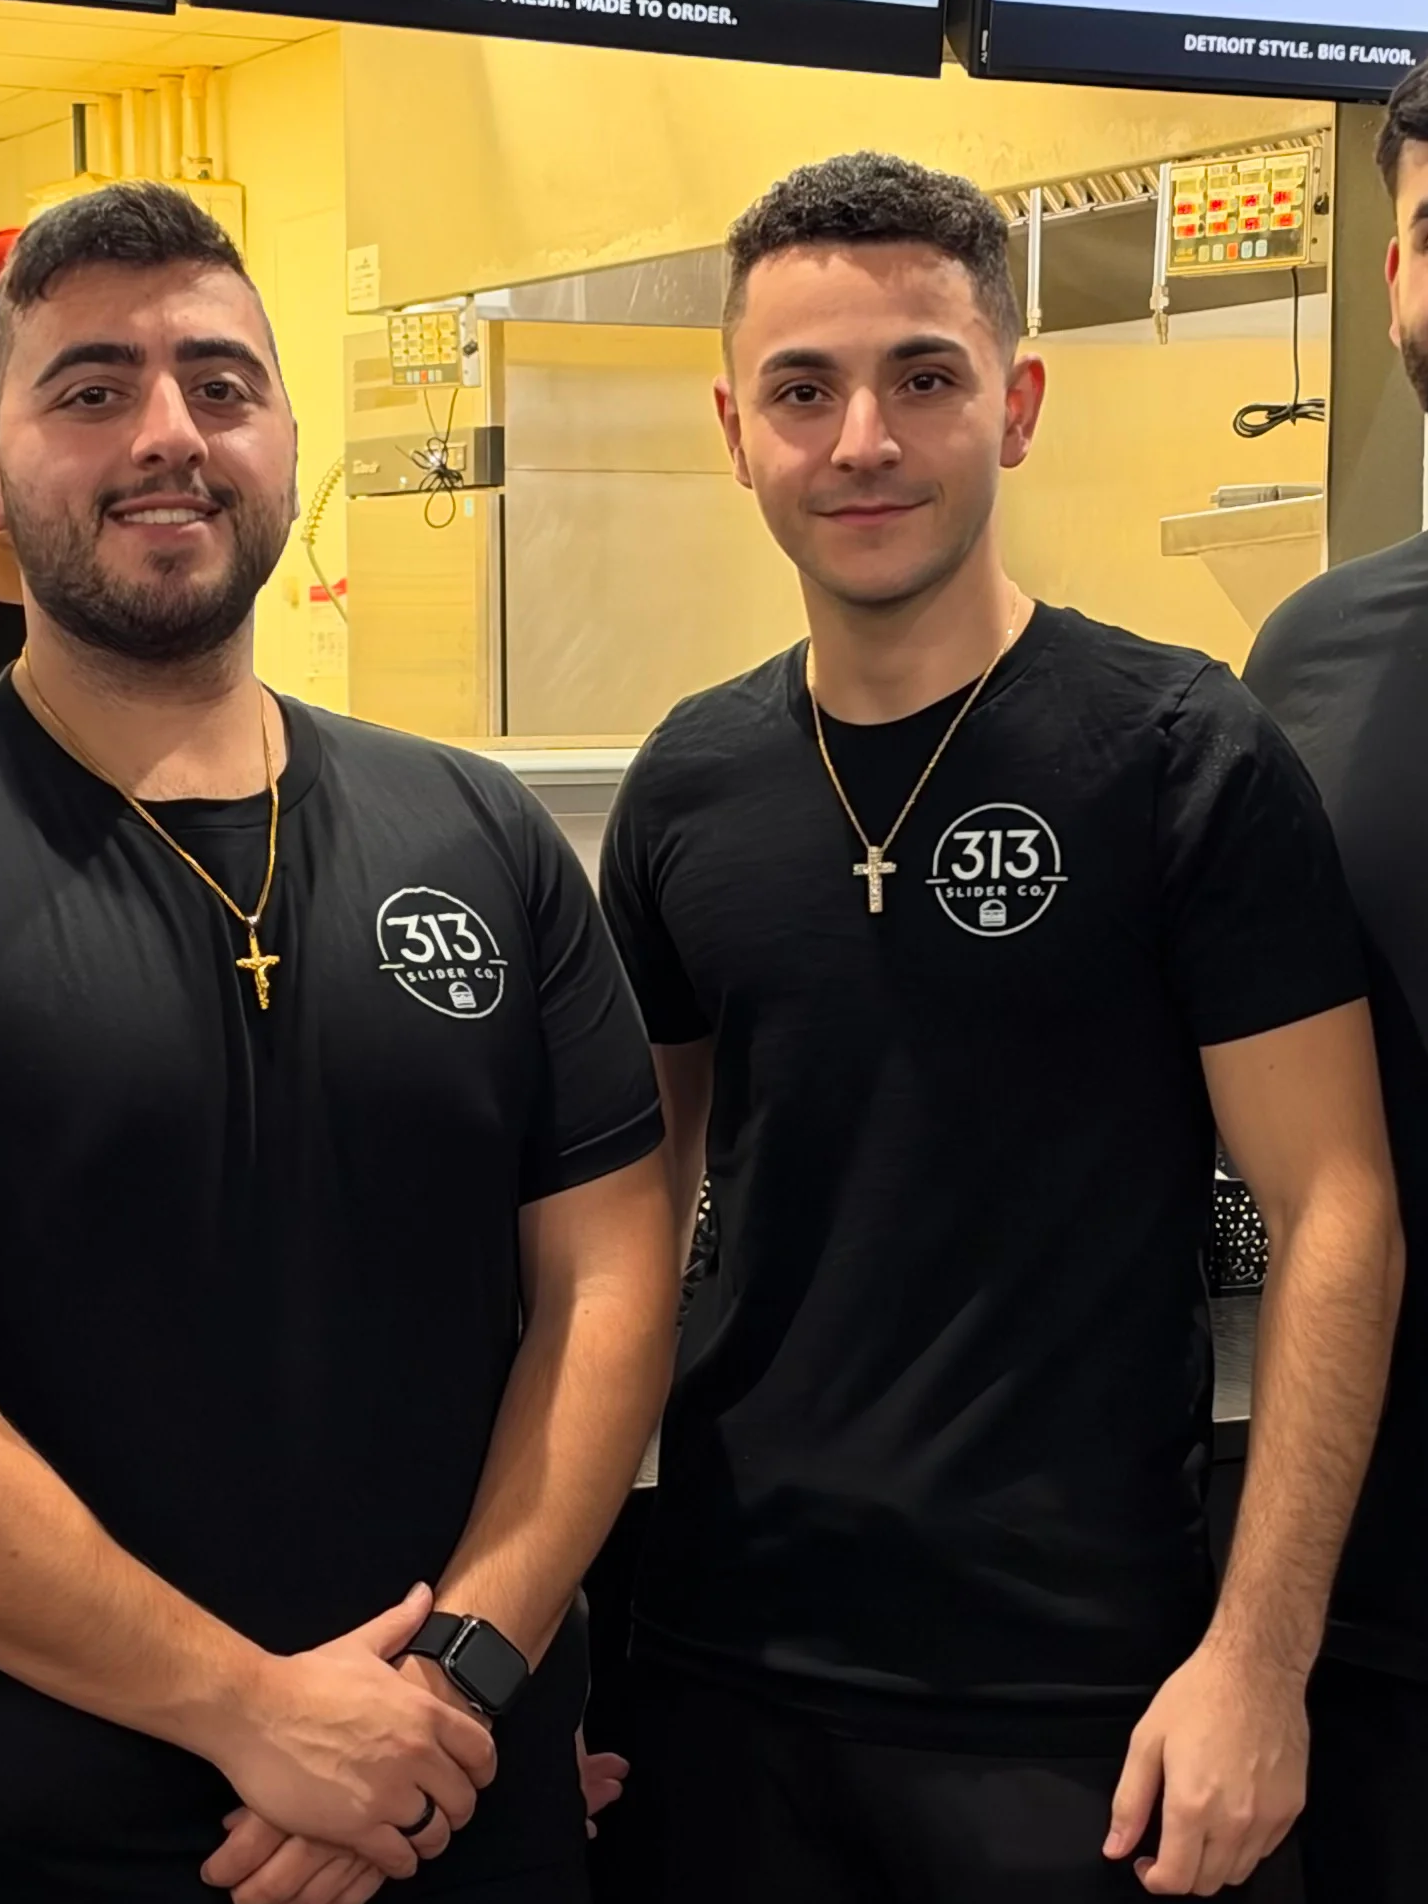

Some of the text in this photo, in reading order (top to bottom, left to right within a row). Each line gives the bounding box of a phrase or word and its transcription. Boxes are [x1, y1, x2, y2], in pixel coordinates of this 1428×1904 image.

[951, 830, 1040, 881] 313
[946, 885, 1045, 898] SLIDER CO.
[386, 913, 481, 963] 313
[406, 968, 498, 982] SLIDER CO.
